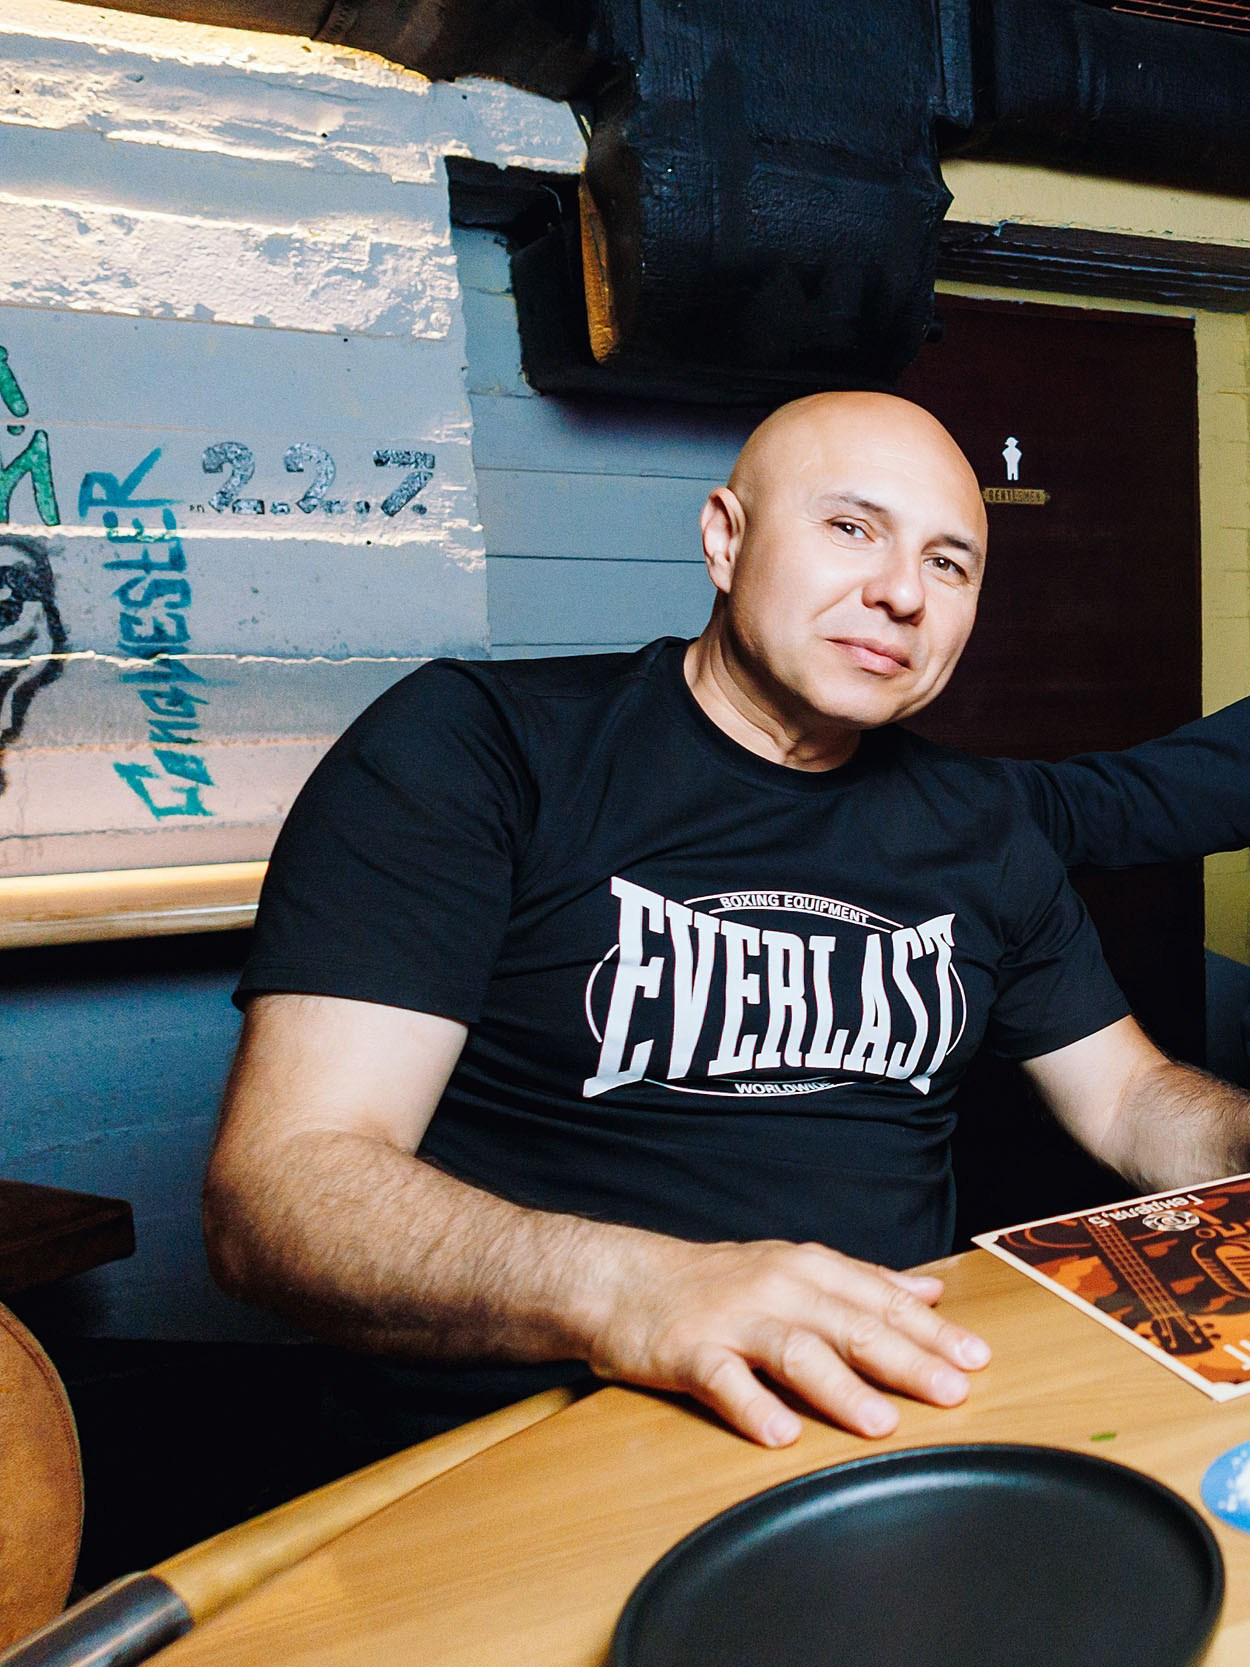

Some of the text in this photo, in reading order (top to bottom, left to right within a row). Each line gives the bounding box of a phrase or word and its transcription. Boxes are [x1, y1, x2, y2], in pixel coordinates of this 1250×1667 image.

[720, 893, 870, 924] BOXING EQUIPMENT
[582, 876, 956, 1098] EVERLAST
